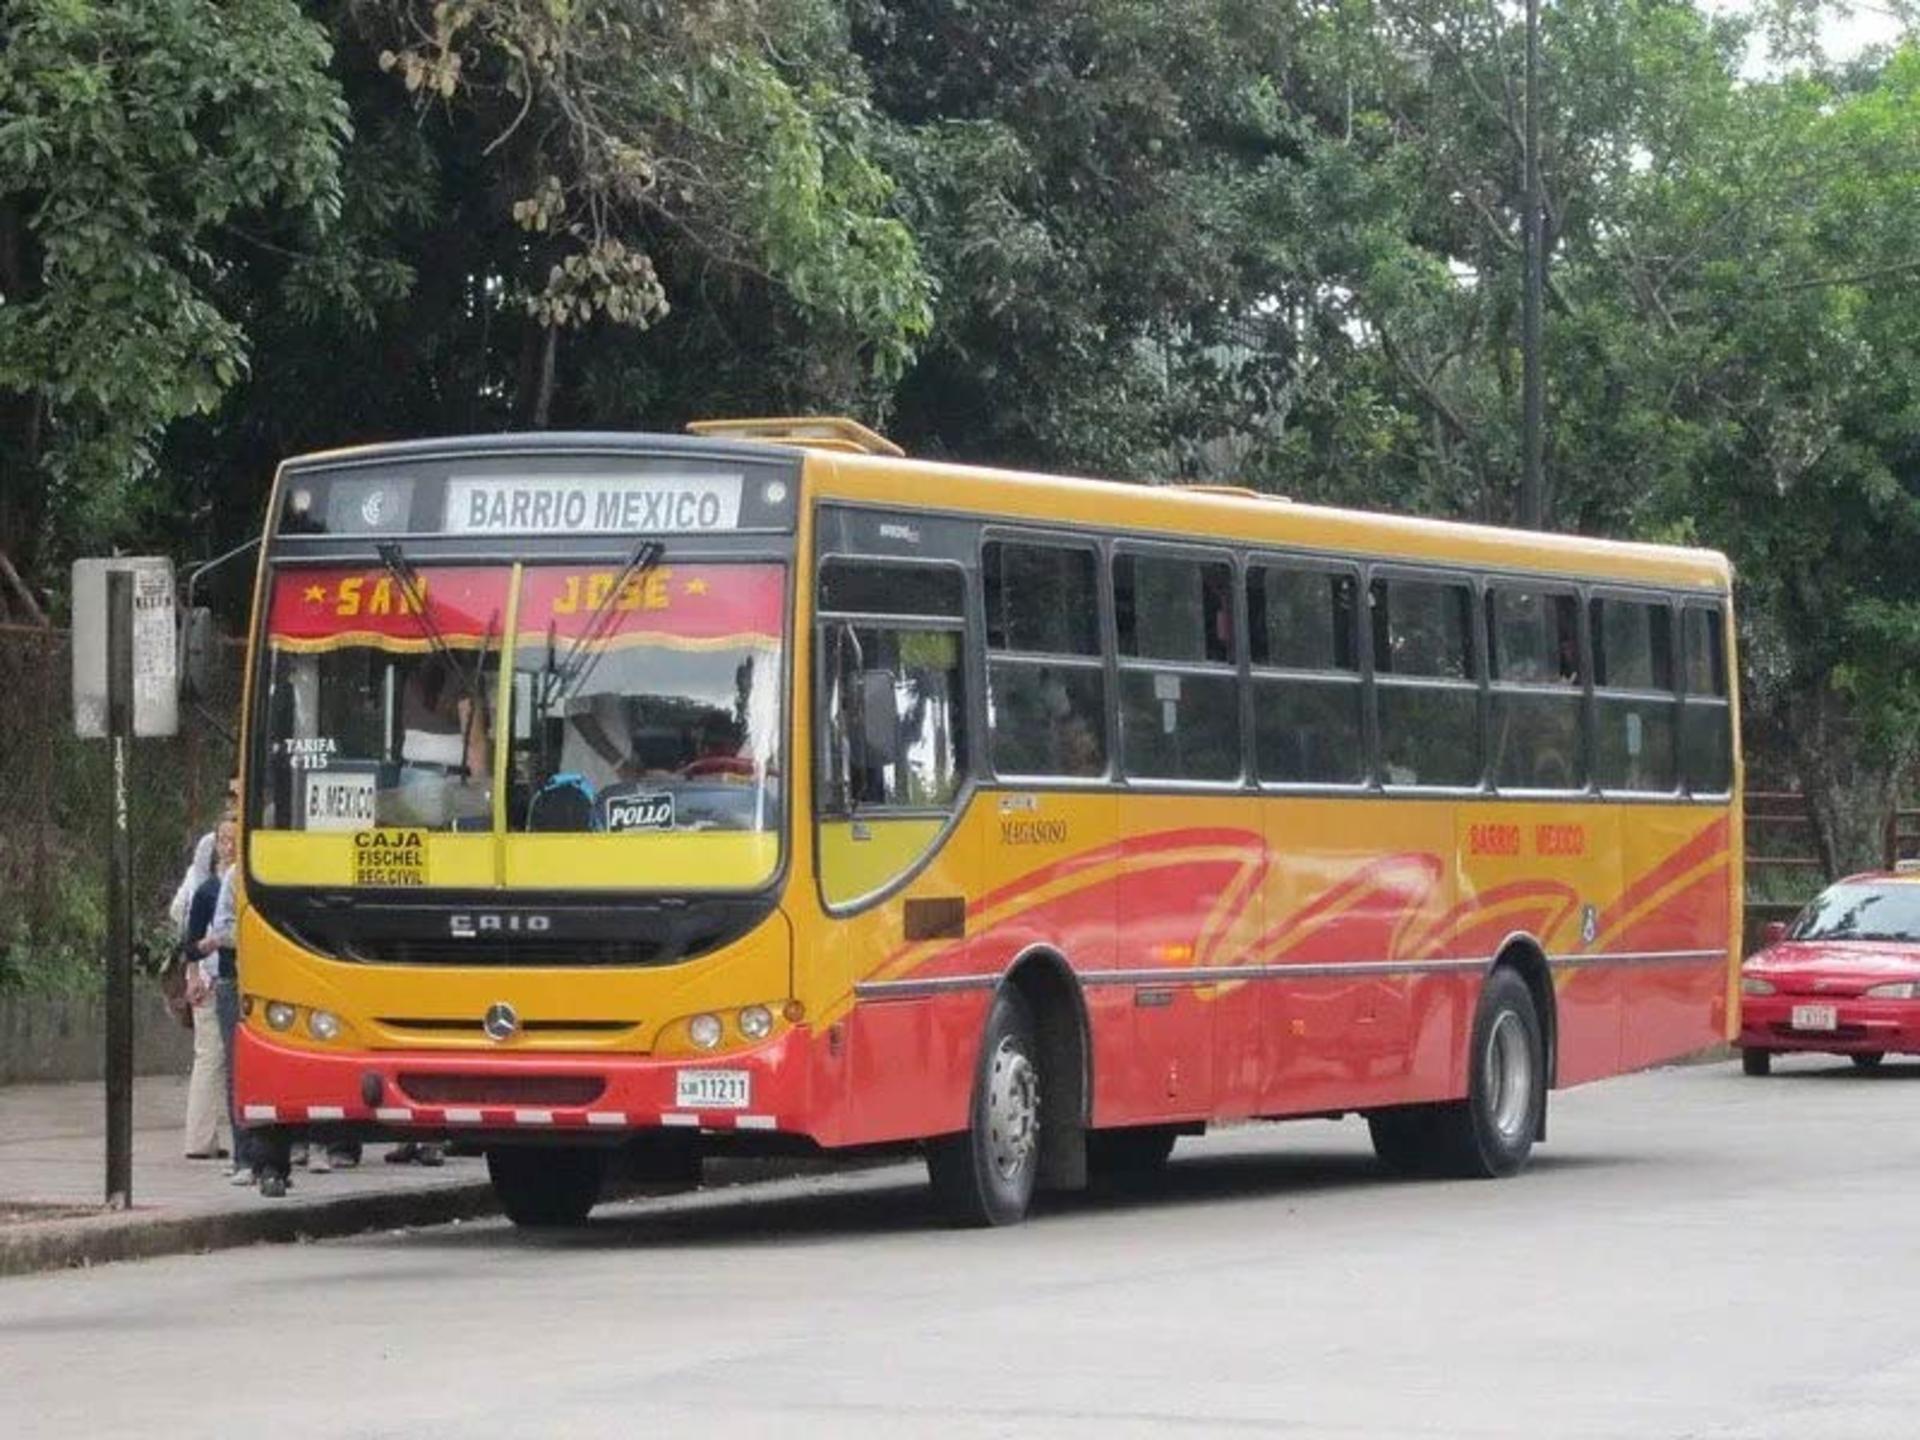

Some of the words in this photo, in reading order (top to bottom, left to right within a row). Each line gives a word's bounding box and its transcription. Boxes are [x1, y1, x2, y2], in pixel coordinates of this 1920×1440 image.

[468, 489, 587, 528] BARRIO
[594, 490, 721, 528] MEXICO
[336, 575, 430, 615] SAN
[552, 567, 673, 614] JOSE
[284, 738, 336, 754] TARIFA
[326, 785, 373, 818] MEXICO
[611, 803, 671, 826] POLLO
[354, 831, 422, 848] CAJA
[1469, 823, 1520, 856] BARRIO
[1535, 823, 1587, 856] MEXICO
[357, 849, 423, 867] FISCHEL
[450, 915, 551, 935] CAIO
